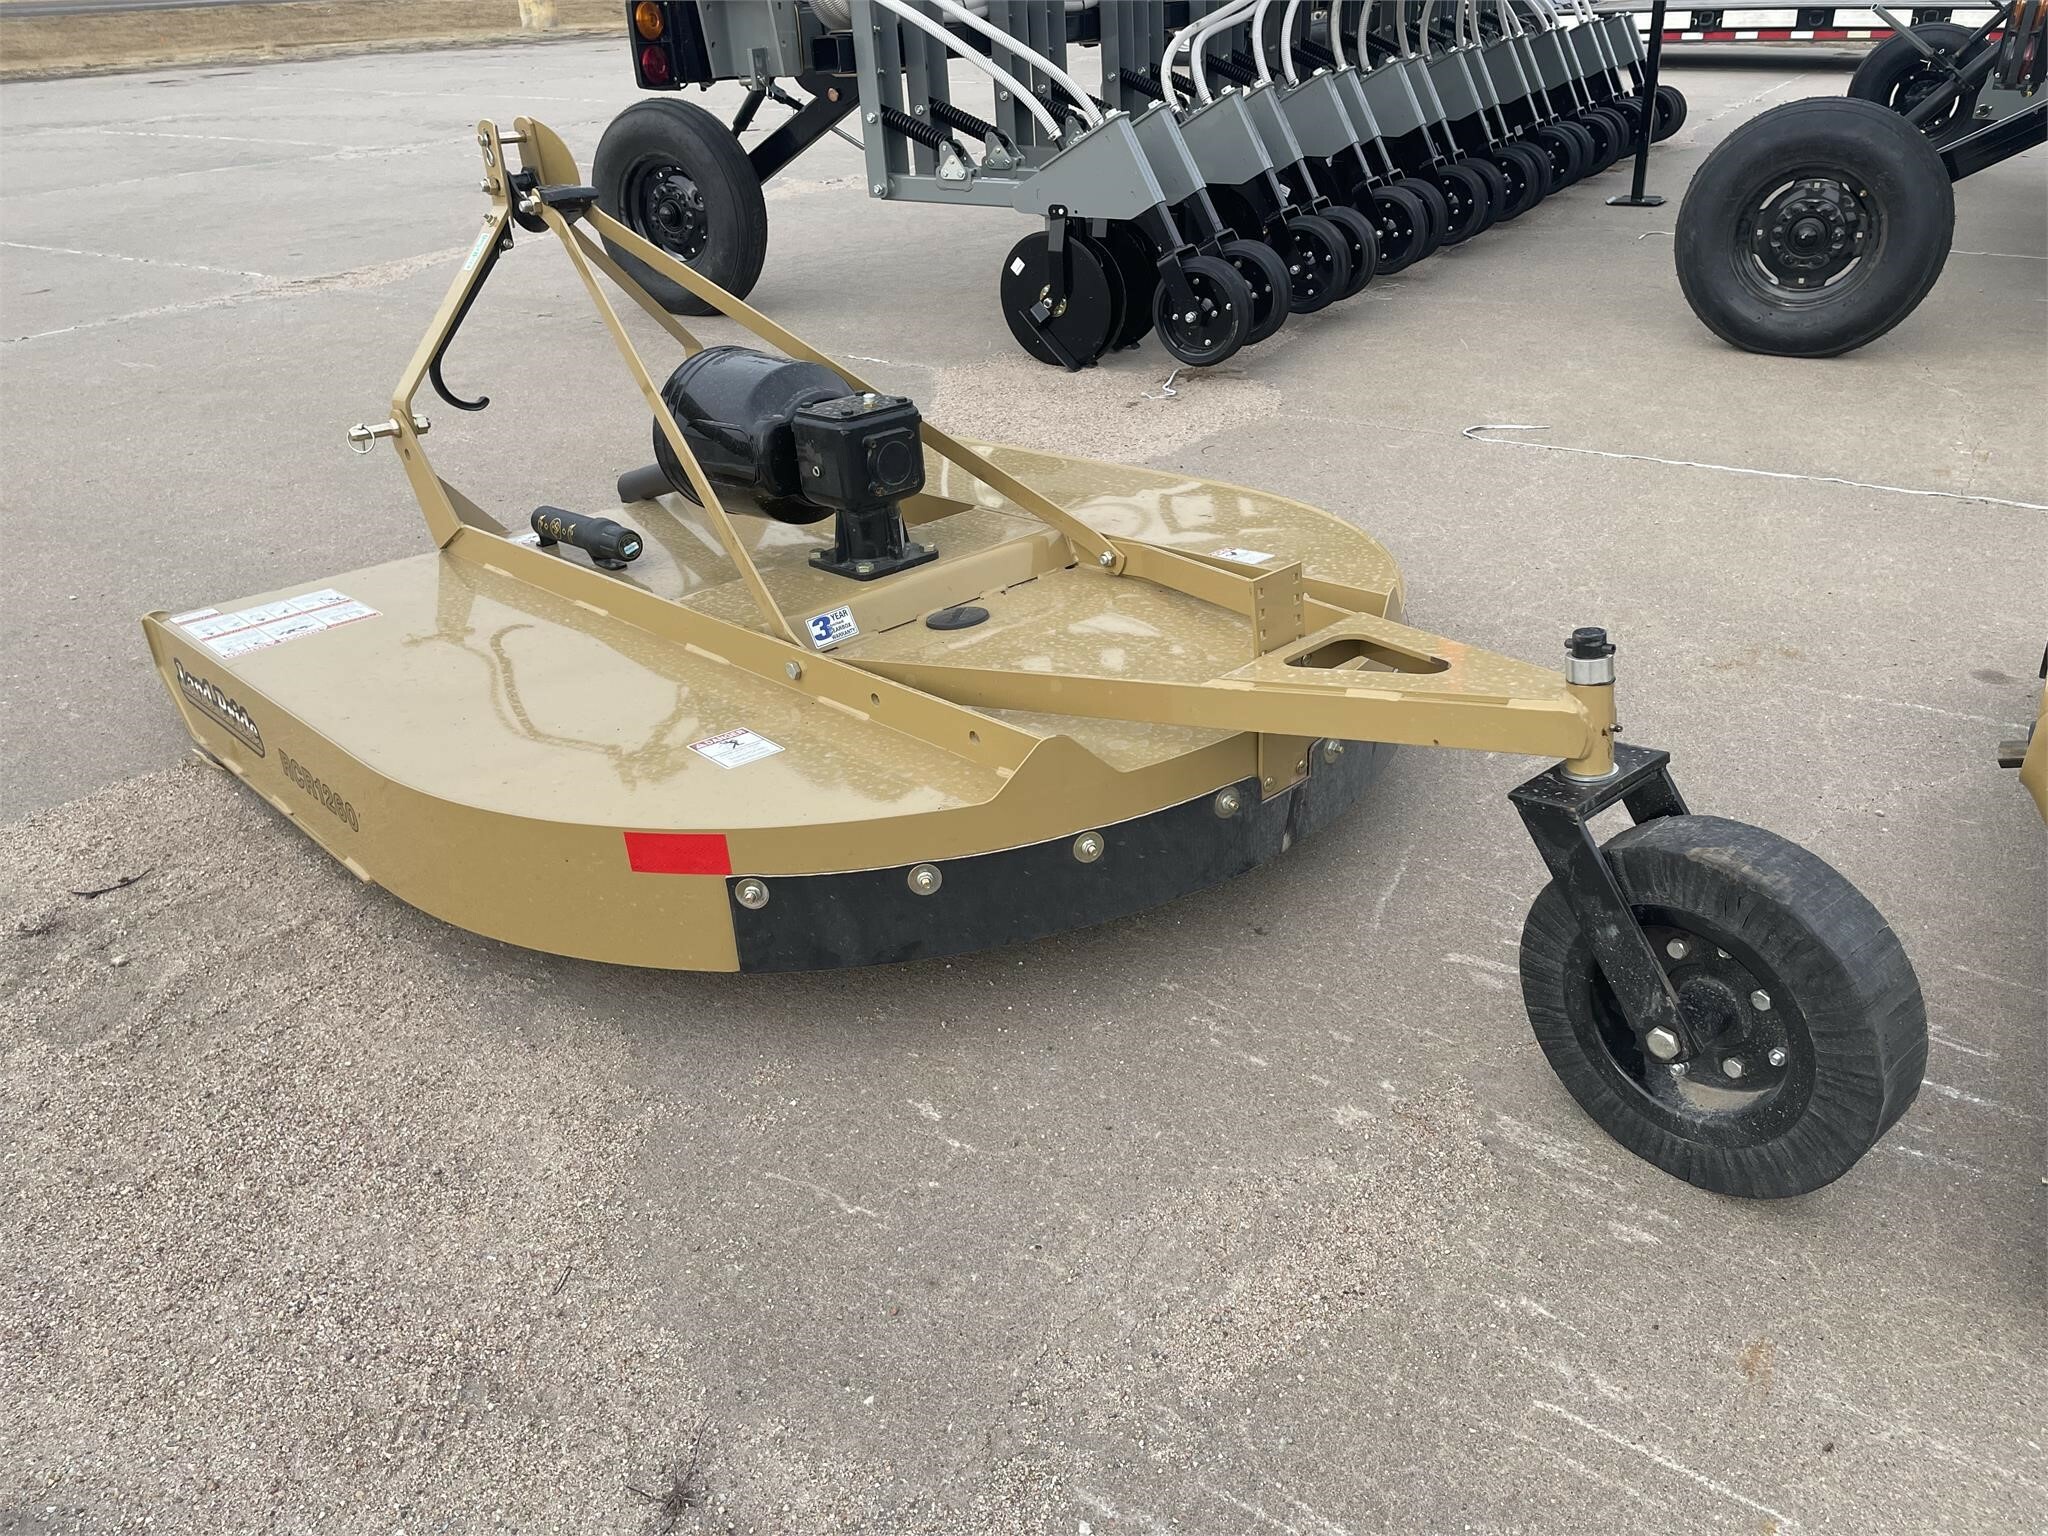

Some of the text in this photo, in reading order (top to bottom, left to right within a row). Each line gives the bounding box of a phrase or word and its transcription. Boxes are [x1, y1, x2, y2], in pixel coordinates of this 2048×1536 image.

[812, 609, 849, 641] 3 YEAR
[704, 728, 747, 746] DANGER
